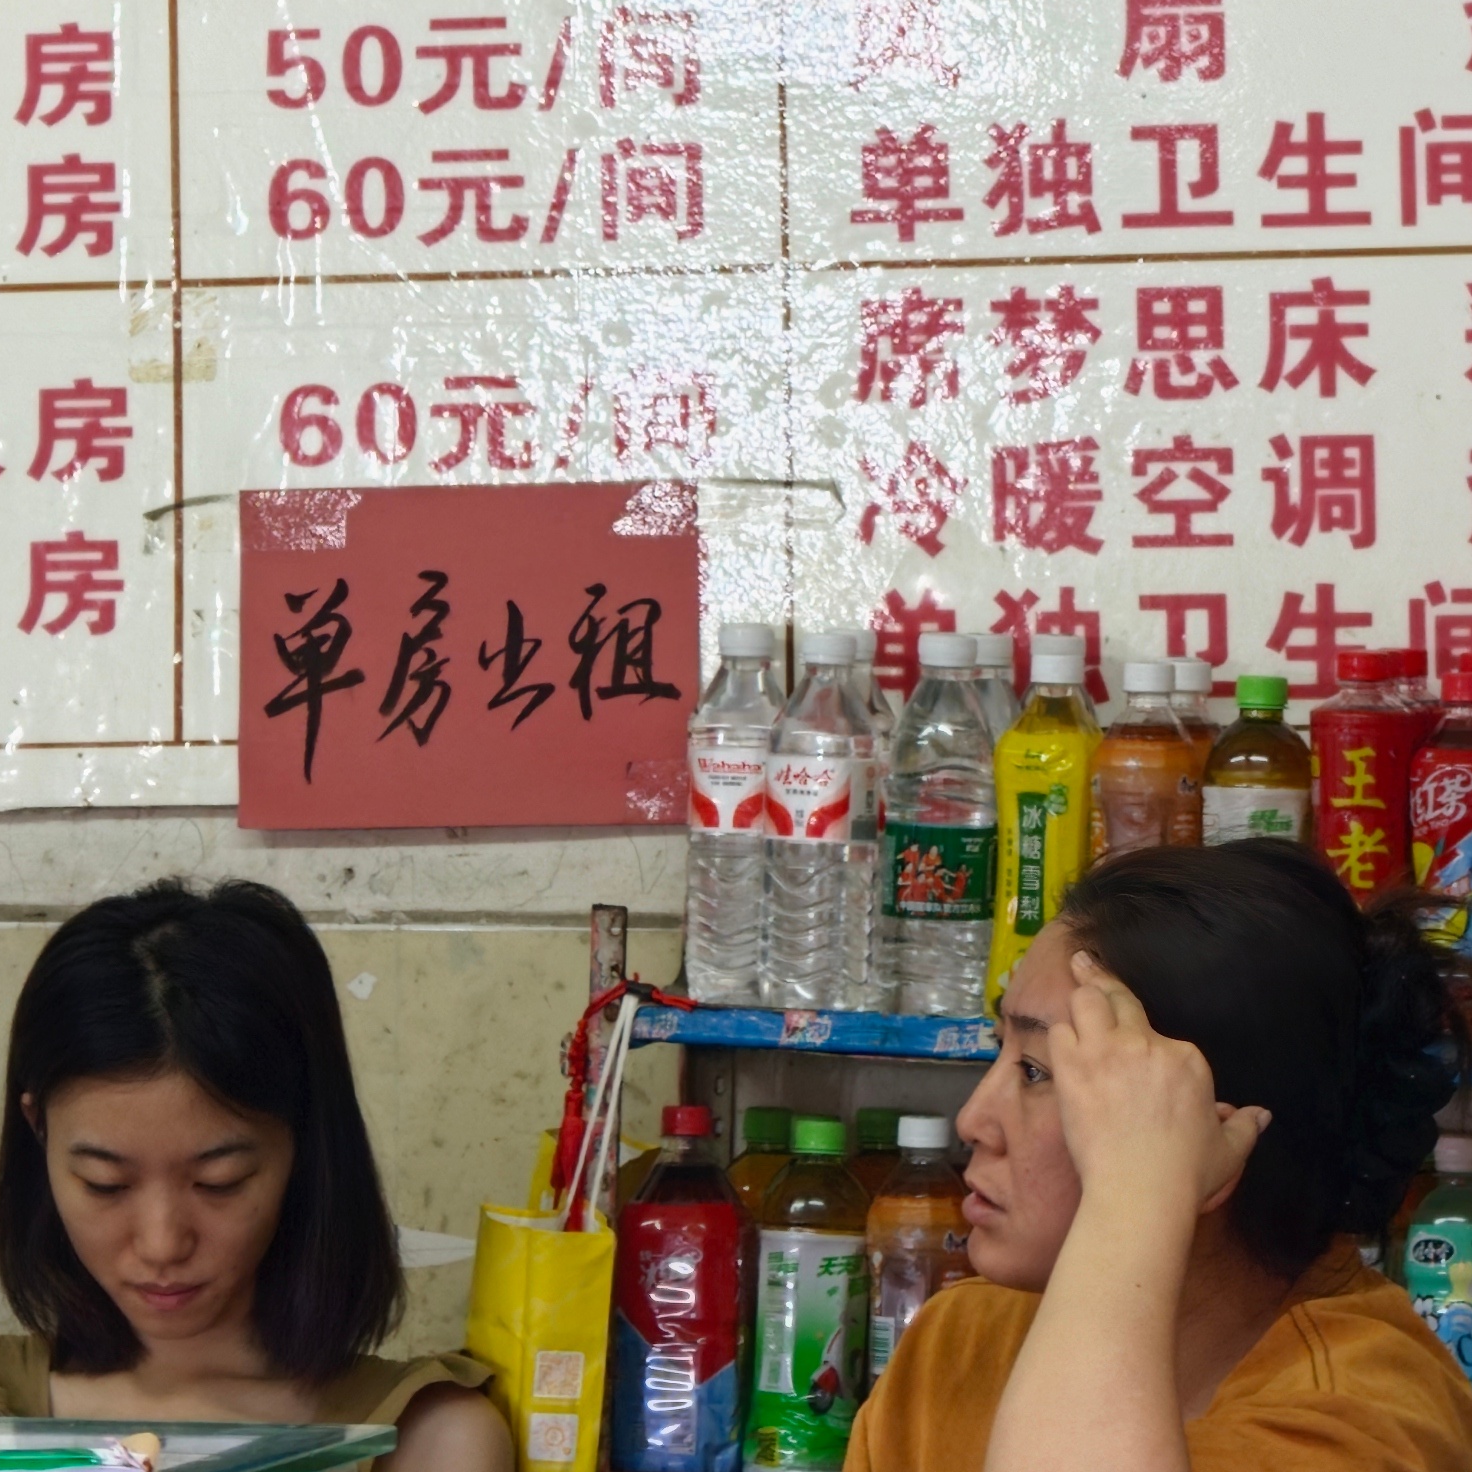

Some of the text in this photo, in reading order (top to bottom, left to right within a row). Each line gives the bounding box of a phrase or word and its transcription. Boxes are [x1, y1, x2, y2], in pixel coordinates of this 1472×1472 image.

[265, 4, 703, 118] 50元/间
[267, 134, 706, 248] 60元/间
[276, 364, 718, 474] 60元/间
[854, 278, 1376, 409] 席梦思床
[857, 431, 1379, 558] 冷暖空调
[264, 564, 684, 784] 单房出租
[697, 757, 765, 774] Wahaha
